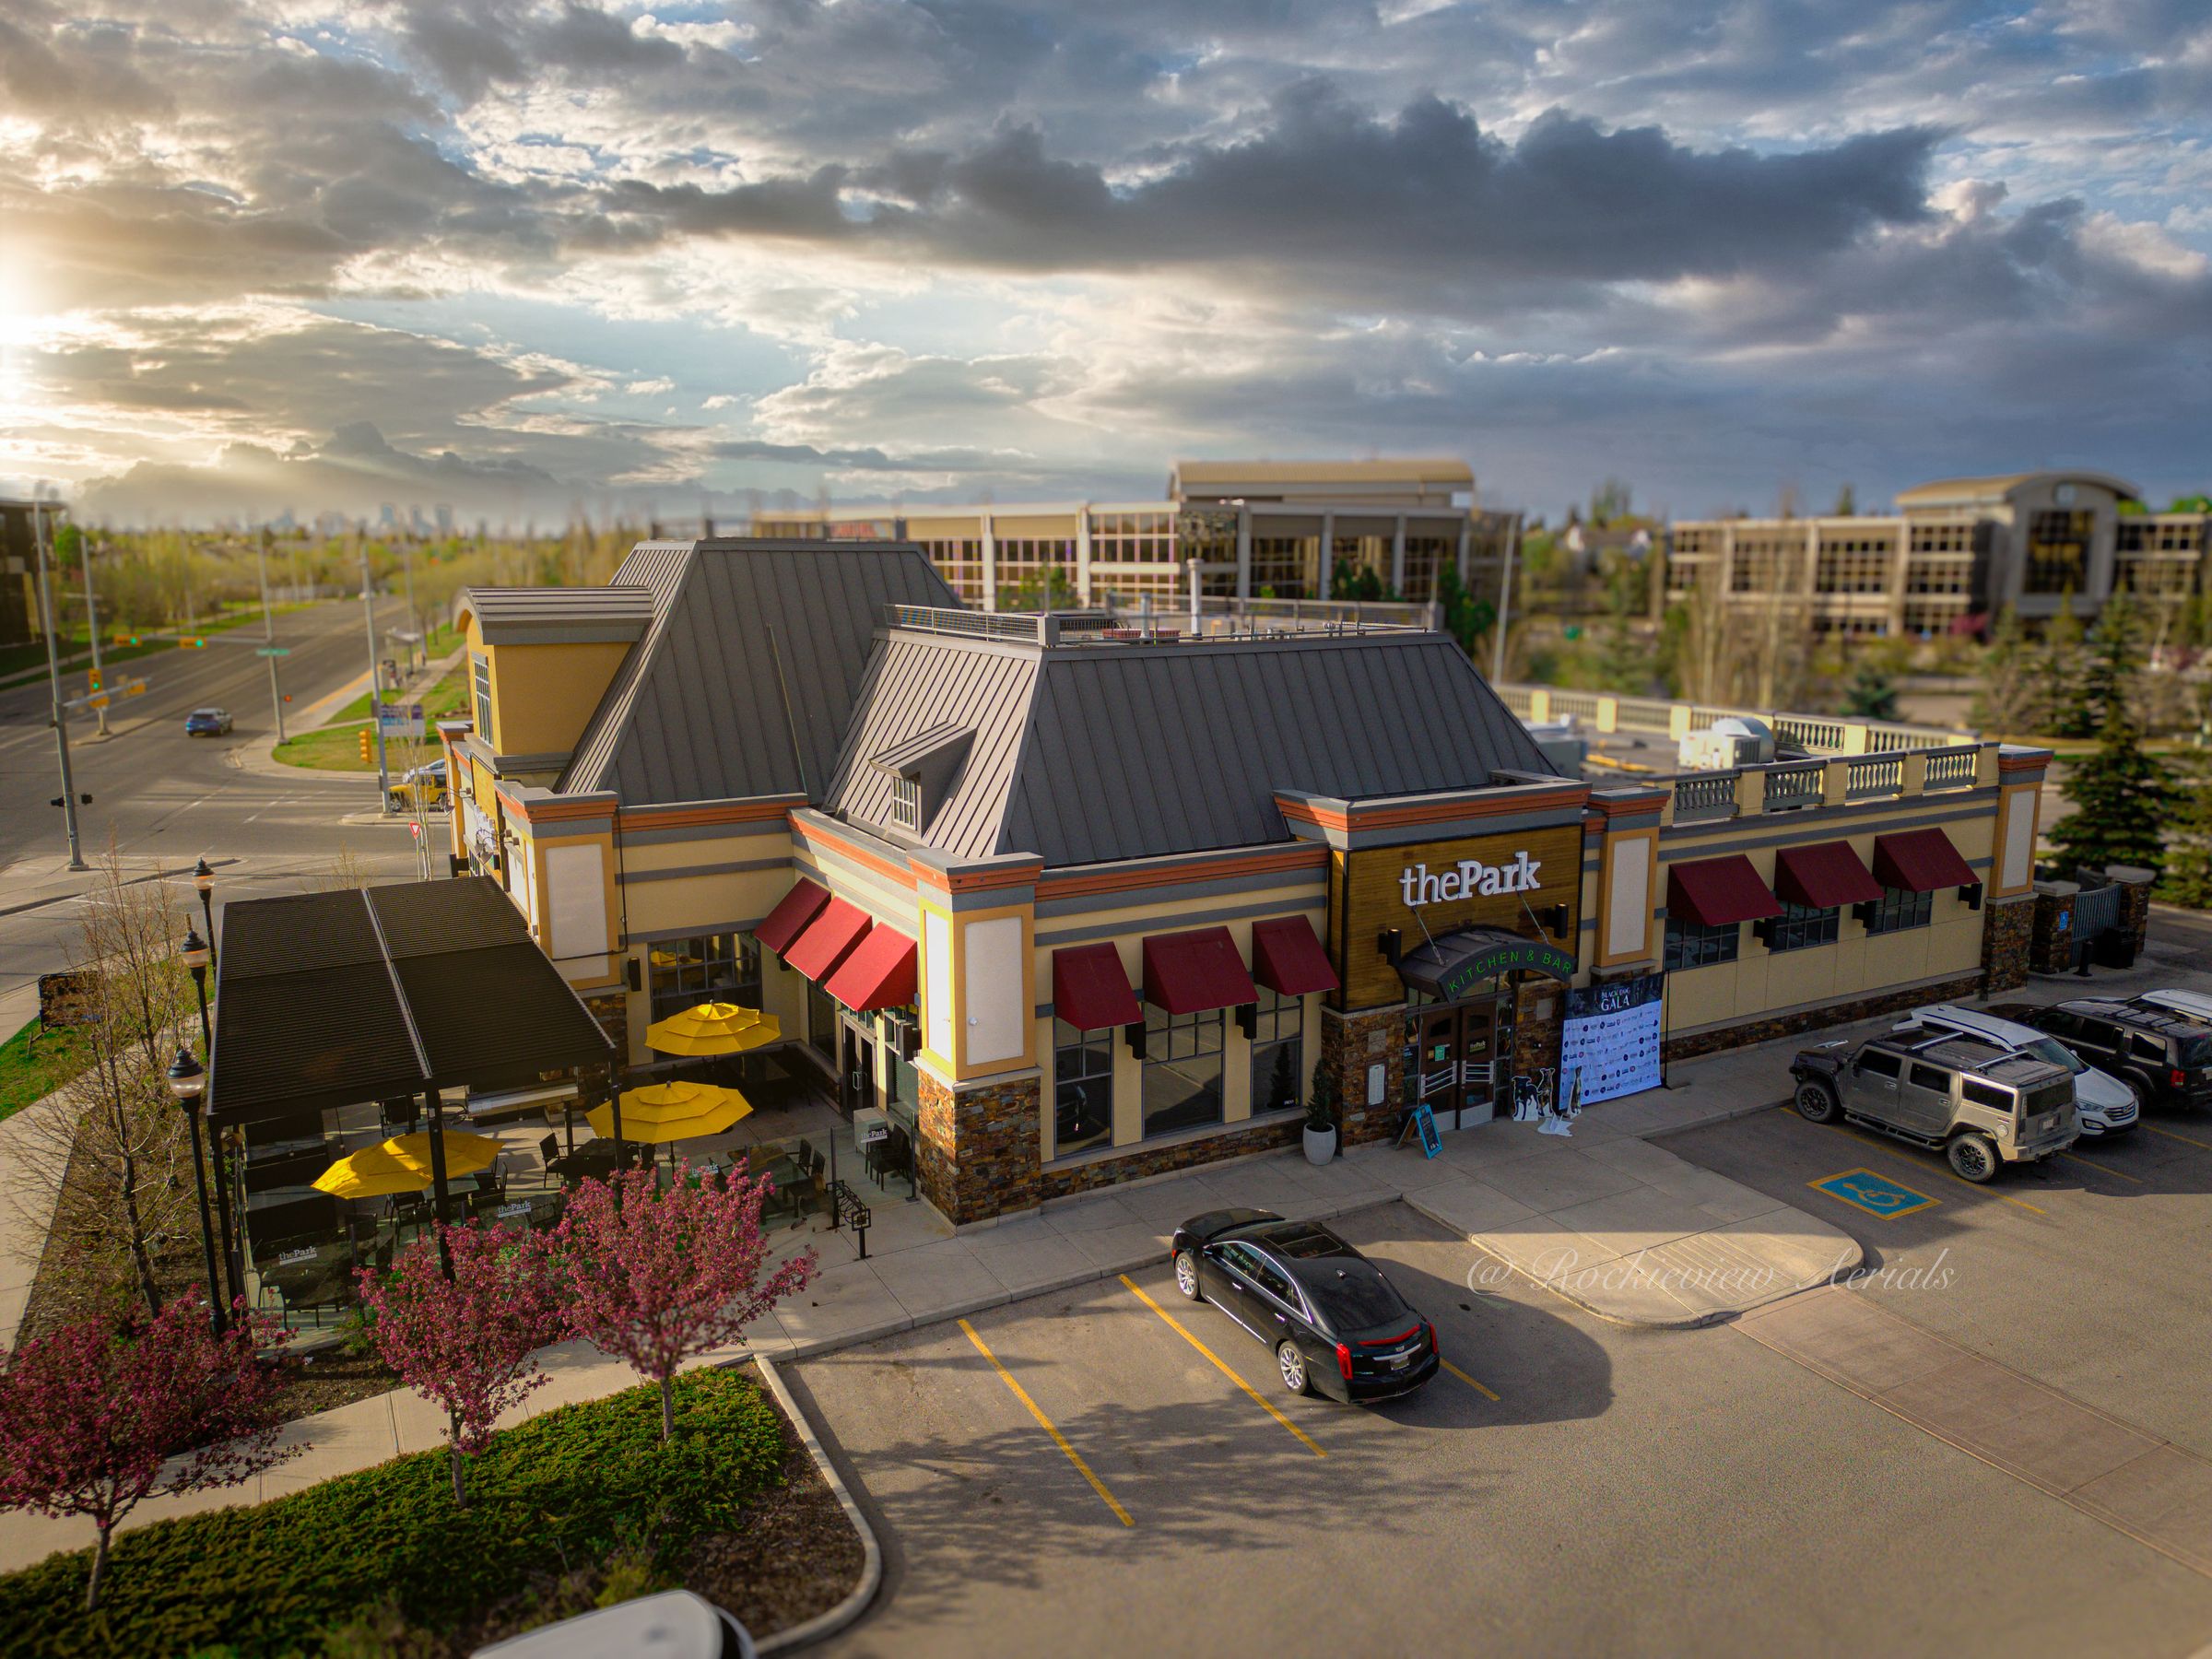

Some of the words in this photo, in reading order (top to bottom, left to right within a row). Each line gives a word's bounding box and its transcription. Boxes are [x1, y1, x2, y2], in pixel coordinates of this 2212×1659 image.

[1397, 850, 1542, 908] thePark
[1448, 950, 1520, 994] KITCHEN
[1526, 949, 1535, 961] &
[1542, 951, 1571, 974] BAR
[1600, 994, 1630, 1012] GALA
[498, 1200, 531, 1213] thePark
[278, 1245, 317, 1260] thePark
